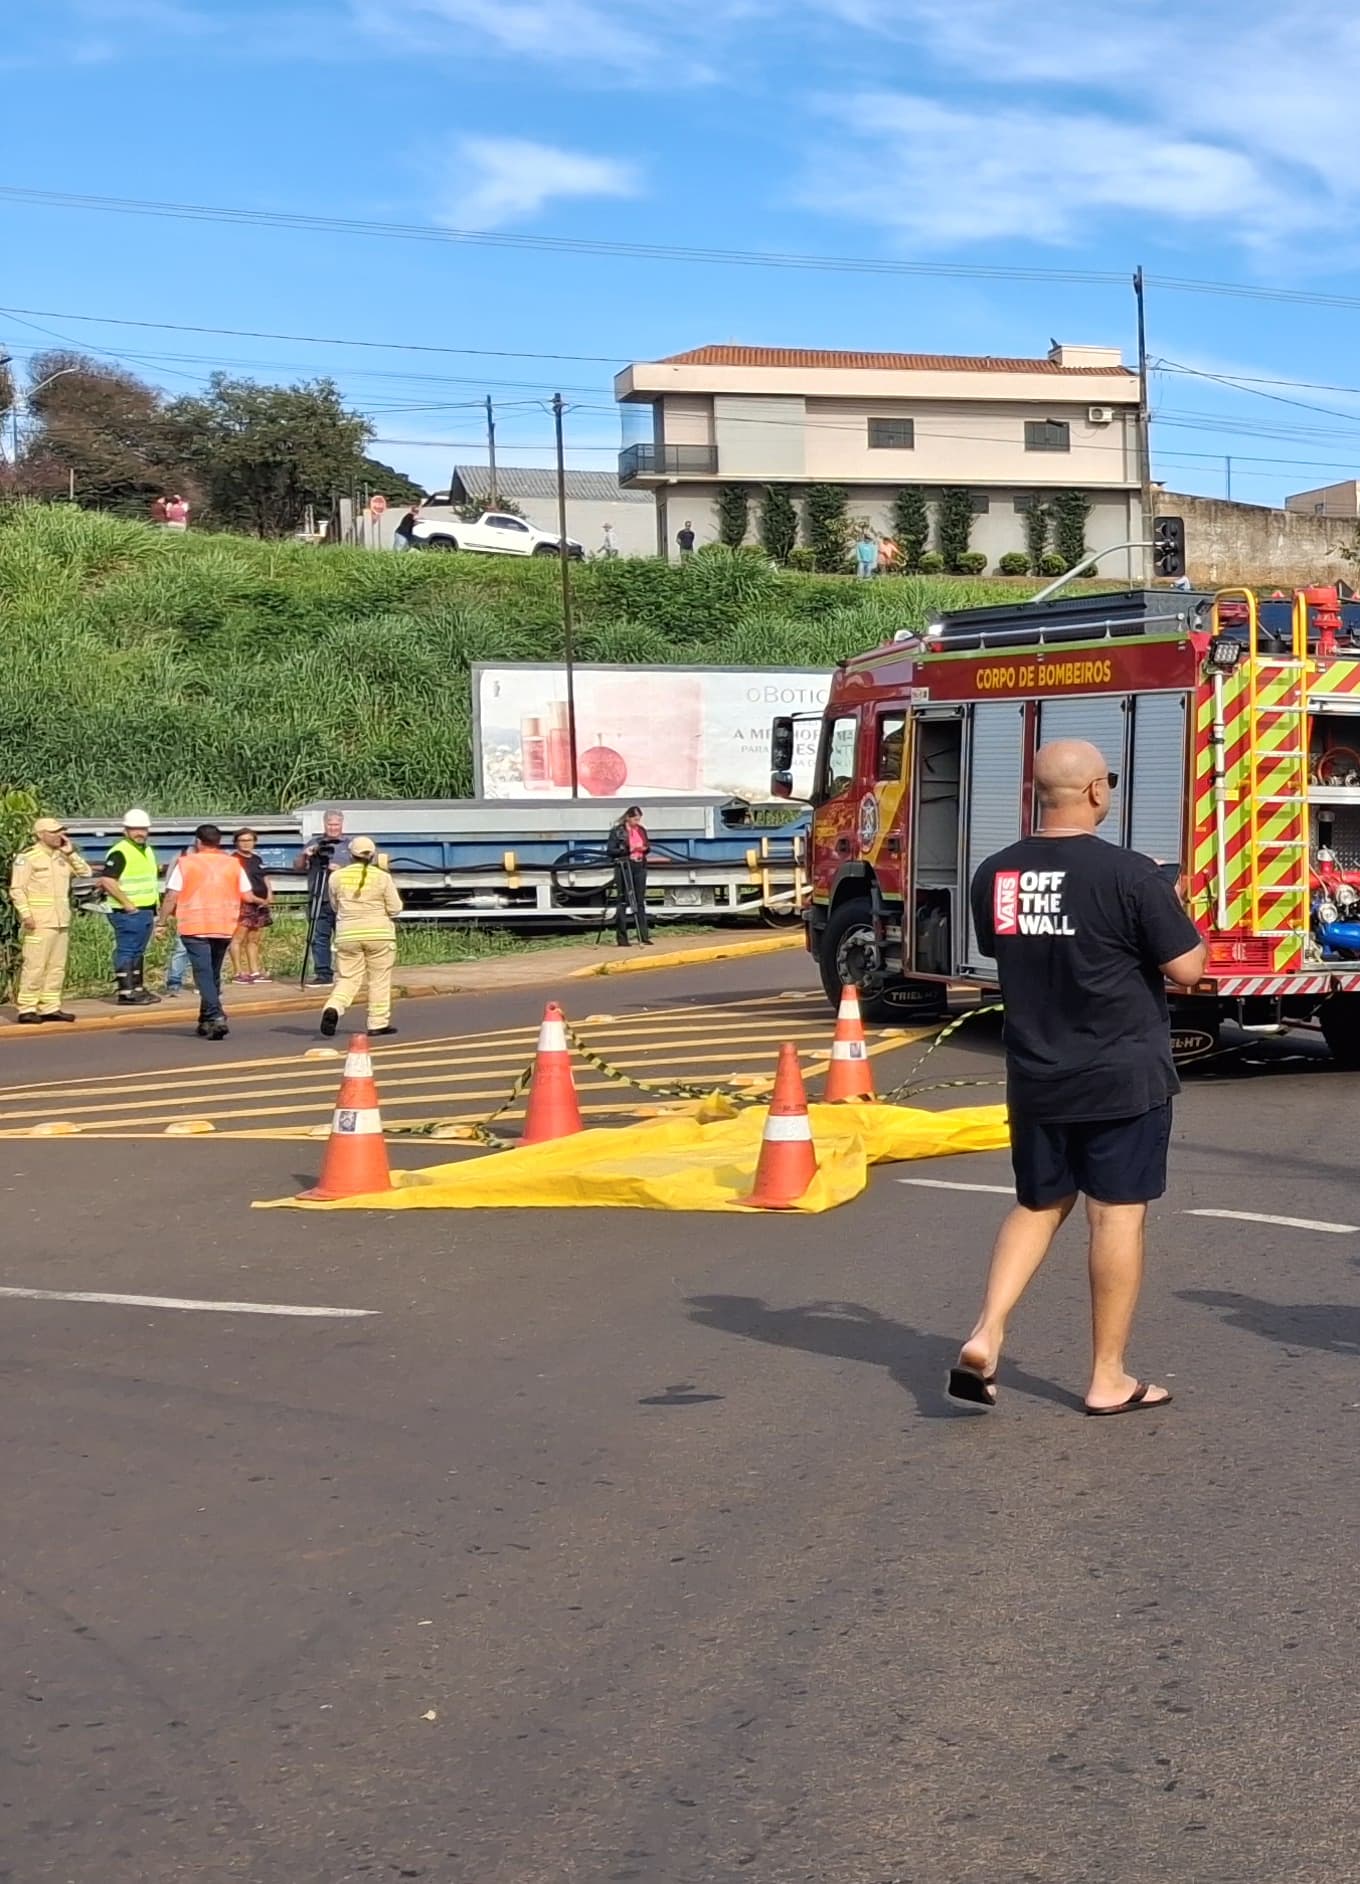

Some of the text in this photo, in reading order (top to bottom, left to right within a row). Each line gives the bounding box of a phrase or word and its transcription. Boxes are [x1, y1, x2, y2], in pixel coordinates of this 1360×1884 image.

[976, 660, 1112, 689] CORPO DE BOMBEIROS
[1020, 871, 1066, 892] OFF
[997, 877, 1016, 932] VANS
[1019, 893, 1062, 913] THE
[1018, 915, 1075, 936] WALL
